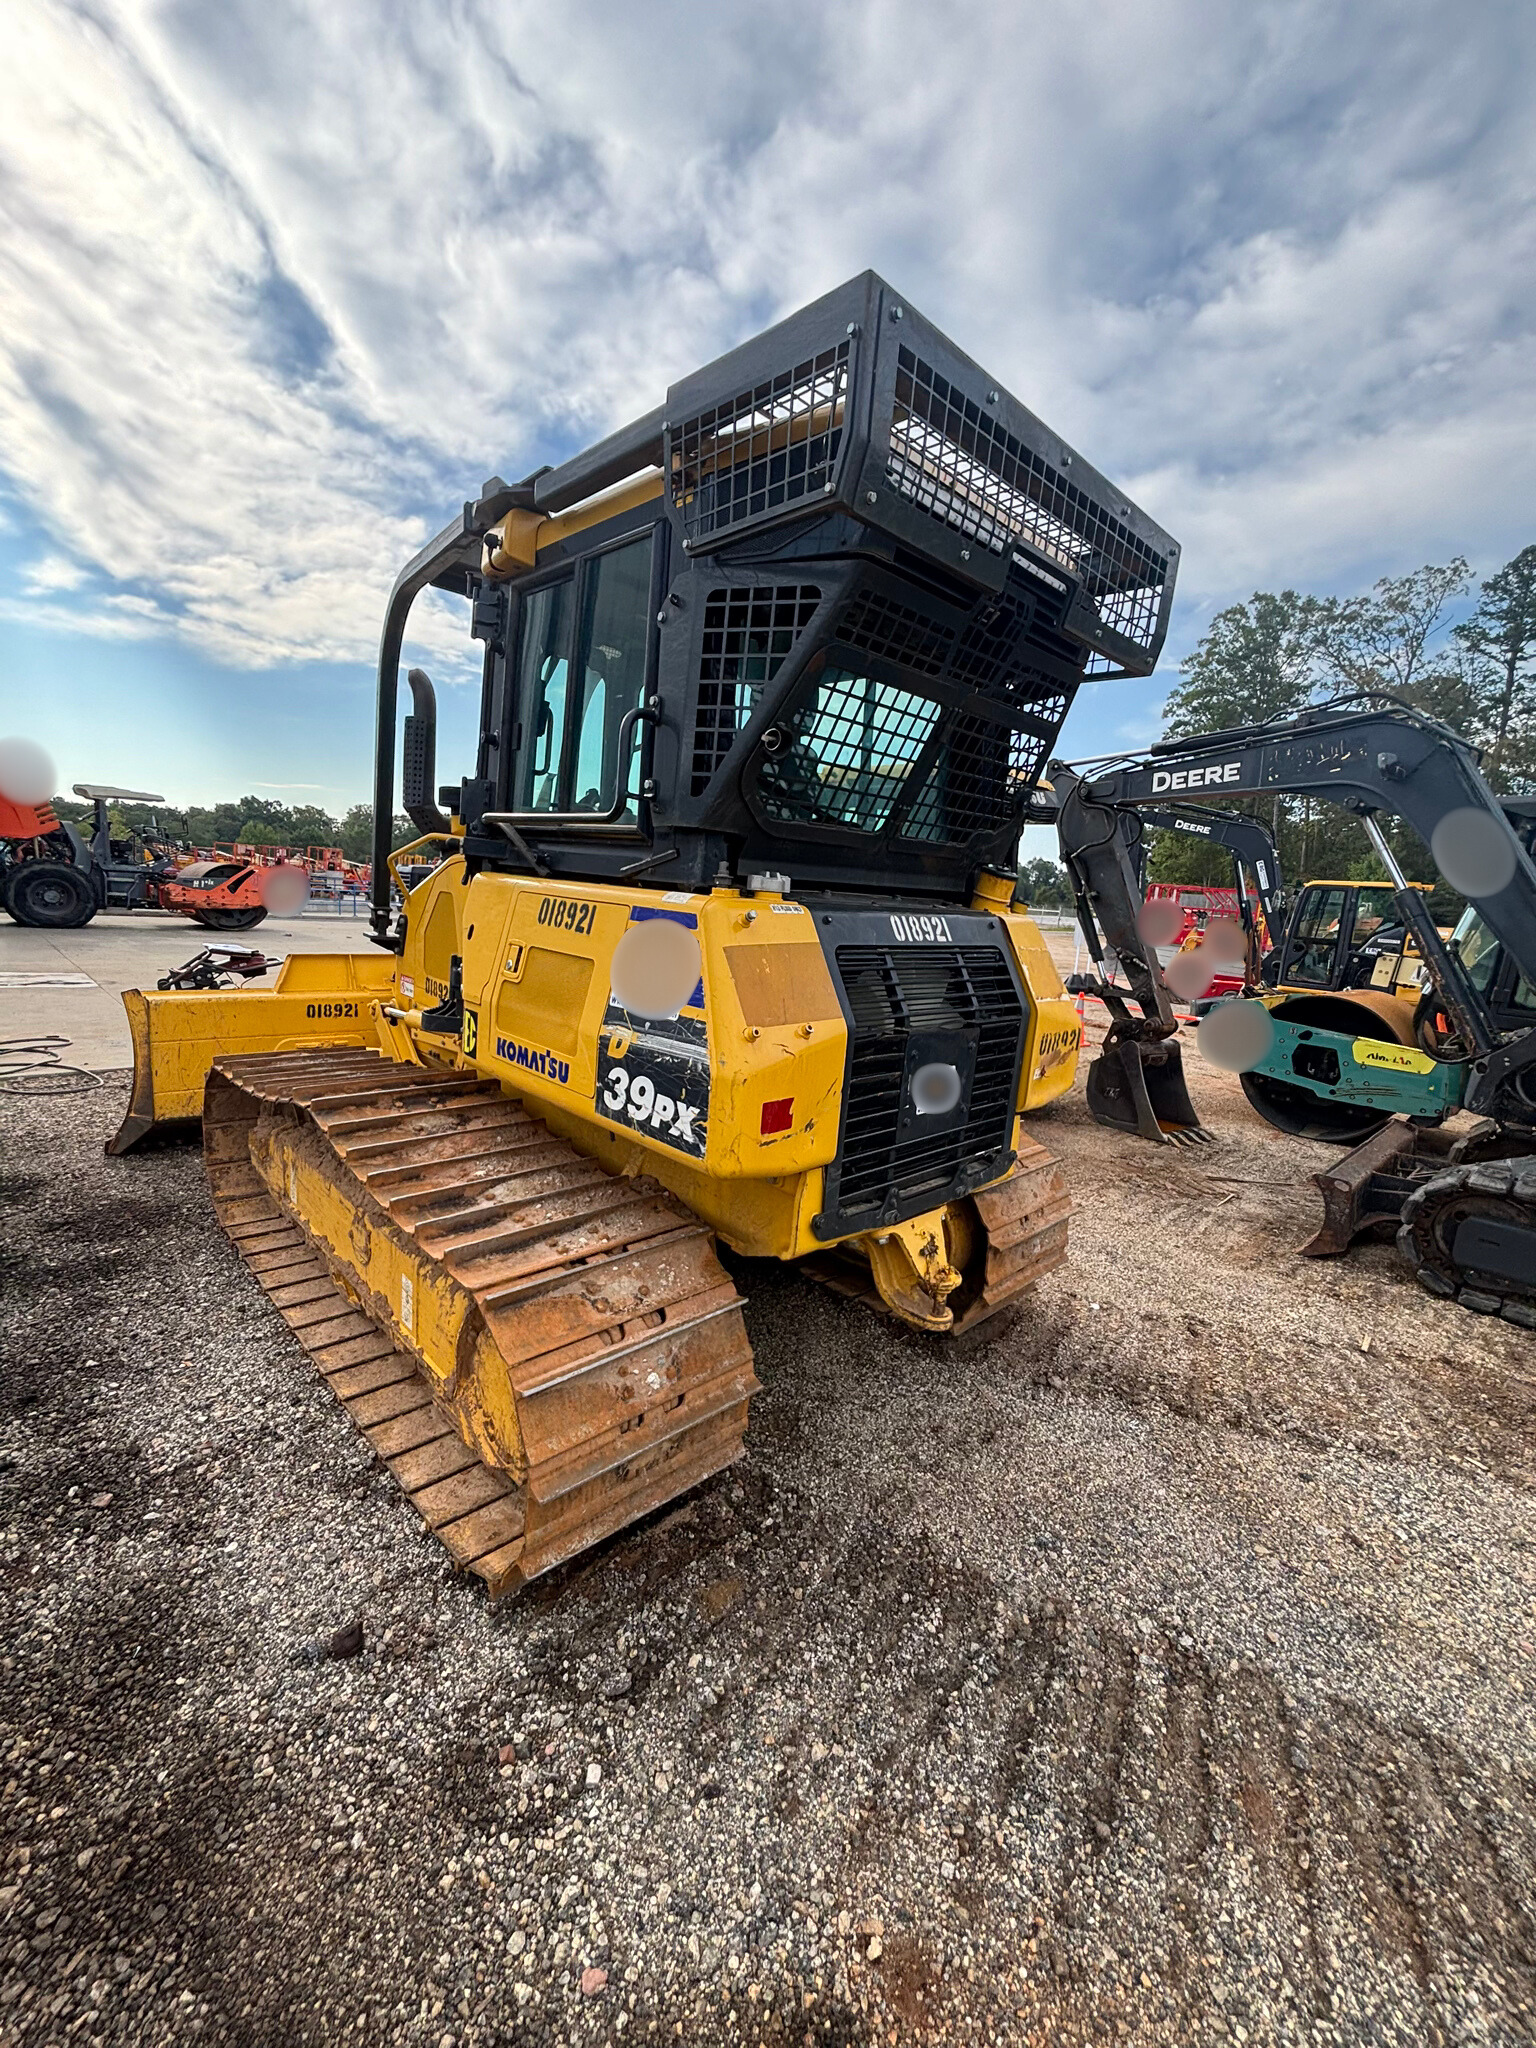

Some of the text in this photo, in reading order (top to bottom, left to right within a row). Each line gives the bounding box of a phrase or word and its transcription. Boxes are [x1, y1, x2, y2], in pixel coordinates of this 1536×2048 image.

[1151, 762, 1241, 793] DEERE
[1174, 819, 1212, 834] DEERE
[537, 897, 597, 935] 018921
[889, 914, 953, 942] 018921
[425, 976, 449, 999] 01892
[306, 1003, 359, 1018] 018921
[496, 1036, 570, 1084] KOMATSU
[603, 1066, 701, 1144] 39PX
